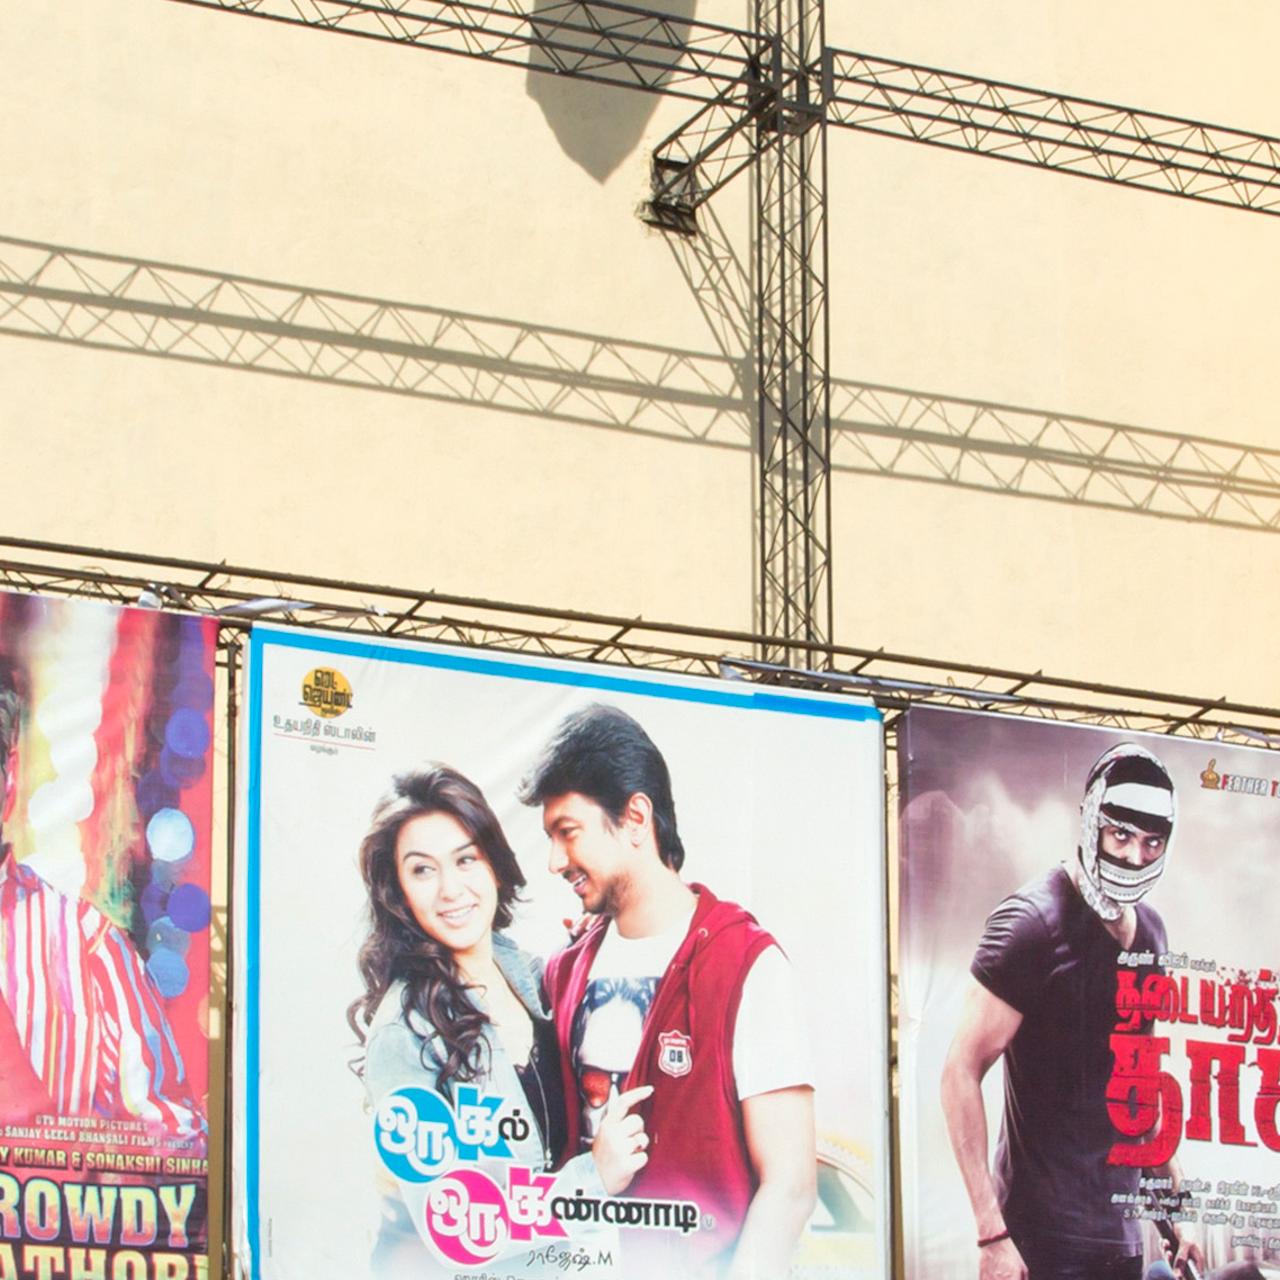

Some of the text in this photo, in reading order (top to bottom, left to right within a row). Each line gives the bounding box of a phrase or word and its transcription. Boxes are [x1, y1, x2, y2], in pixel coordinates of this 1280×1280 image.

[1221, 773, 1268, 796] FEATHER
[13, 1146, 68, 1168] KUMAR
[71, 1149, 83, 1170] &
[86, 1151, 162, 1174] SONAKSHI
